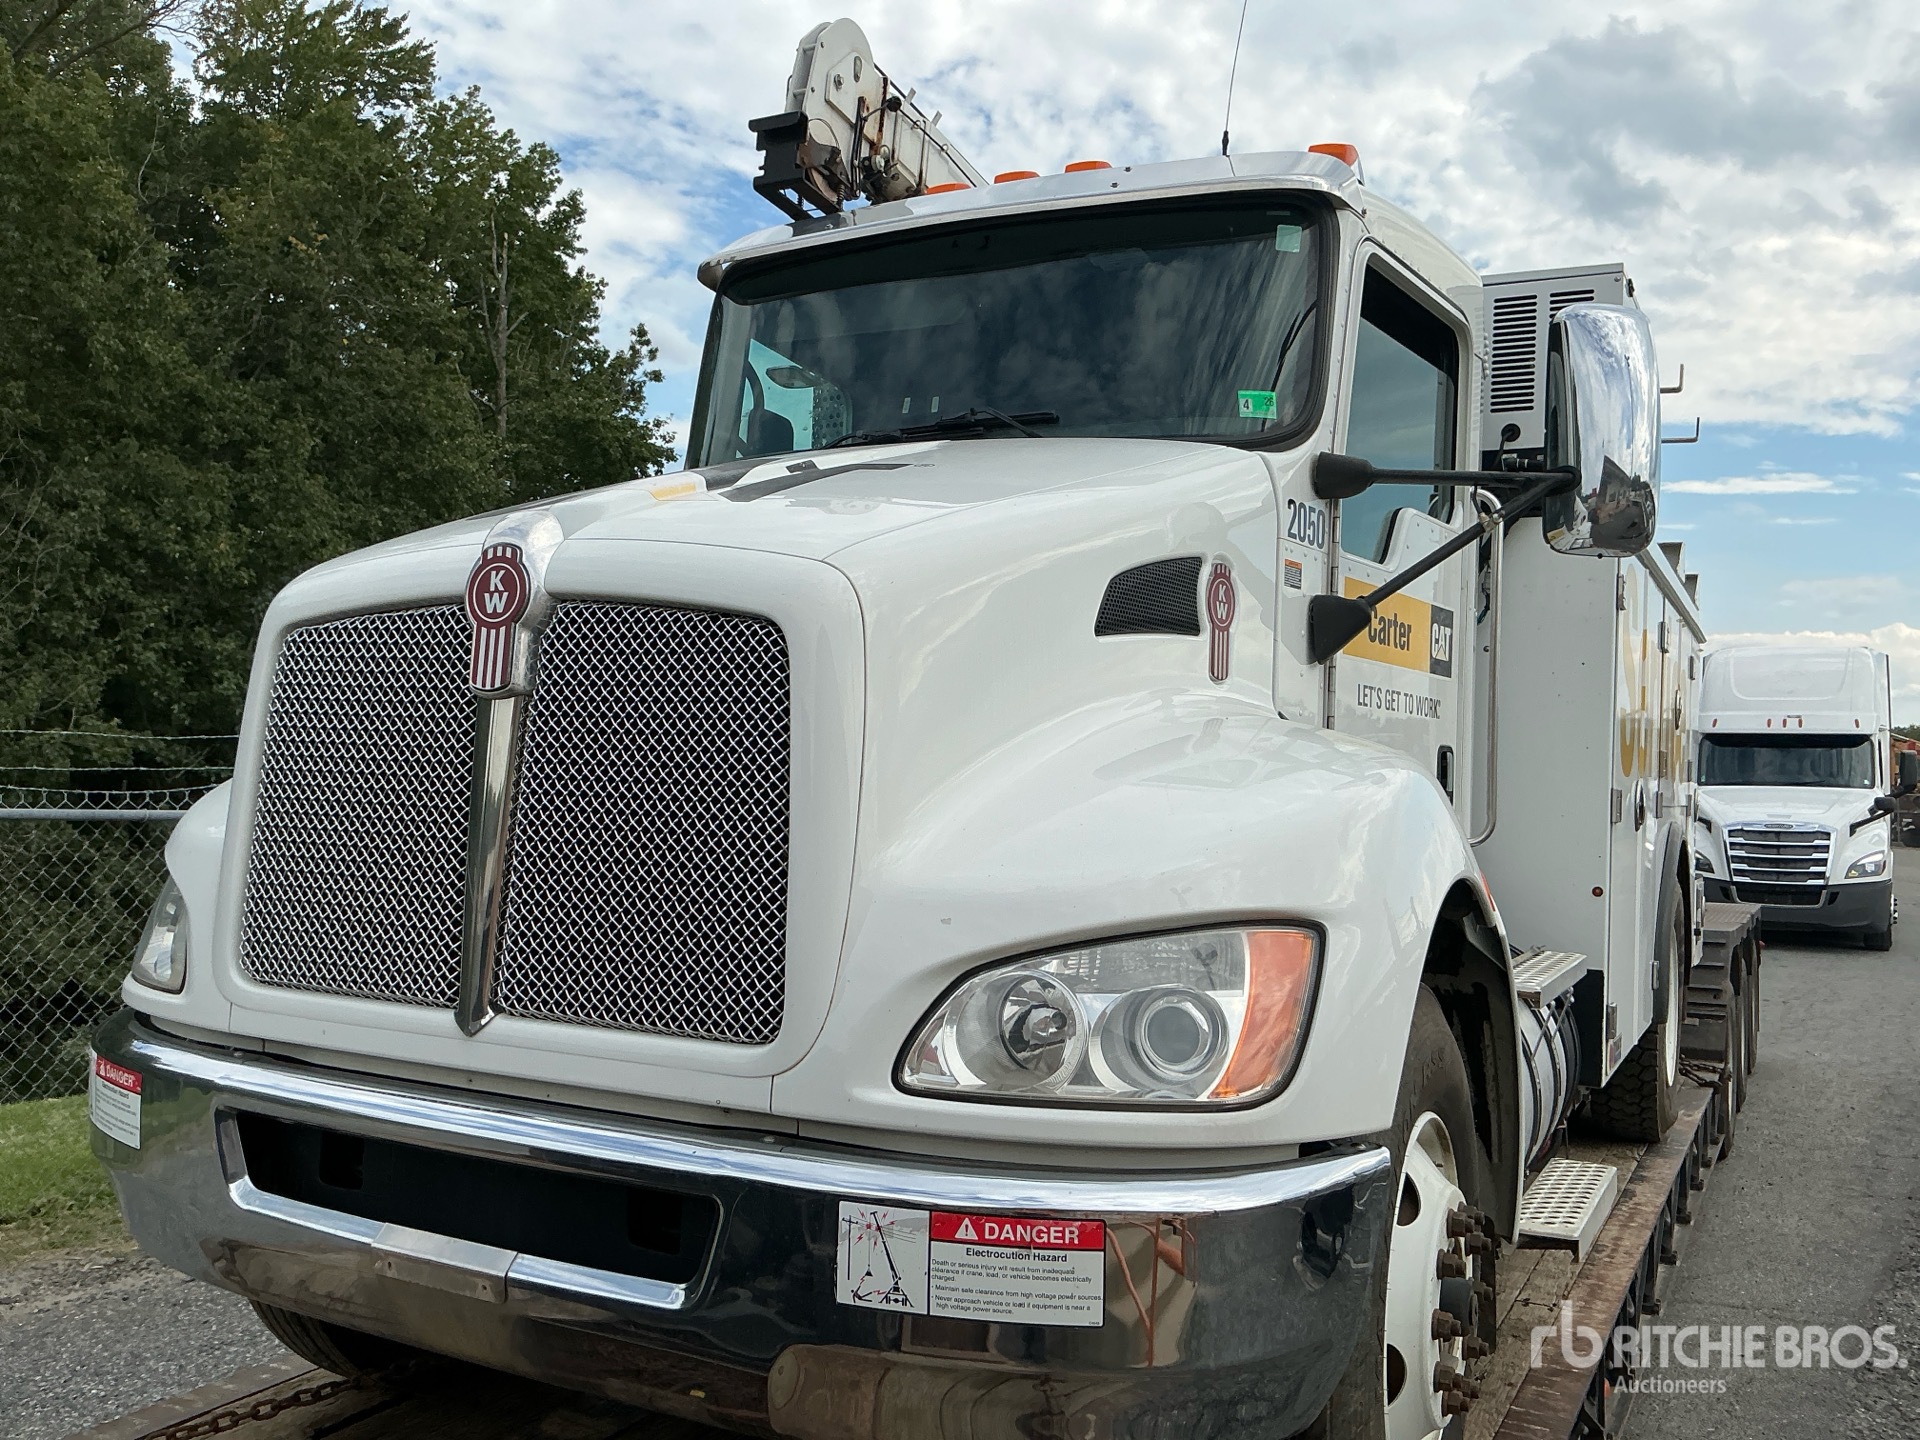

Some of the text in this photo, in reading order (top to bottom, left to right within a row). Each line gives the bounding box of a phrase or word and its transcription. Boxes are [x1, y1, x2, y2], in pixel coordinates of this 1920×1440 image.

[1243, 396, 1275, 410] 4 26
[1287, 498, 1326, 550] 2050
[1367, 604, 1412, 652] Carter
[1431, 622, 1451, 662] CAT
[1357, 683, 1383, 710] LET'S
[1384, 689, 1401, 712] GET
[1403, 692, 1414, 715] TO
[106, 1065, 134, 1087] DANGER
[984, 1222, 1079, 1245] DANGER
[966, 1247, 1068, 1263] Electrocution Hazard
[931, 1259, 950, 1267] Death
[957, 1262, 980, 1270] serious
[980, 1264, 997, 1272] injury
[997, 1264, 1008, 1272] will
[1027, 1266, 1041, 1274] from
[1042, 1267, 1076, 1276] inadequate
[931, 1267, 960, 1275] clearance
[1031, 1274, 1060, 1283] becomes
[1060, 1276, 1092, 1285] electrically
[935, 1284, 960, 1293] Maintain
[975, 1288, 1004, 1297] clearance
[1005, 1290, 1019, 1298] from
[1020, 1291, 1034, 1300] high
[1034, 1292, 1057, 1301] voltage
[935, 1294, 953, 1302] Never
[953, 1297, 981, 1305] approach
[982, 1299, 1004, 1307] vehicle
[1031, 1303, 1064, 1311] equipment
[935, 1302, 949, 1310] high
[949, 1304, 972, 1312] voltage
